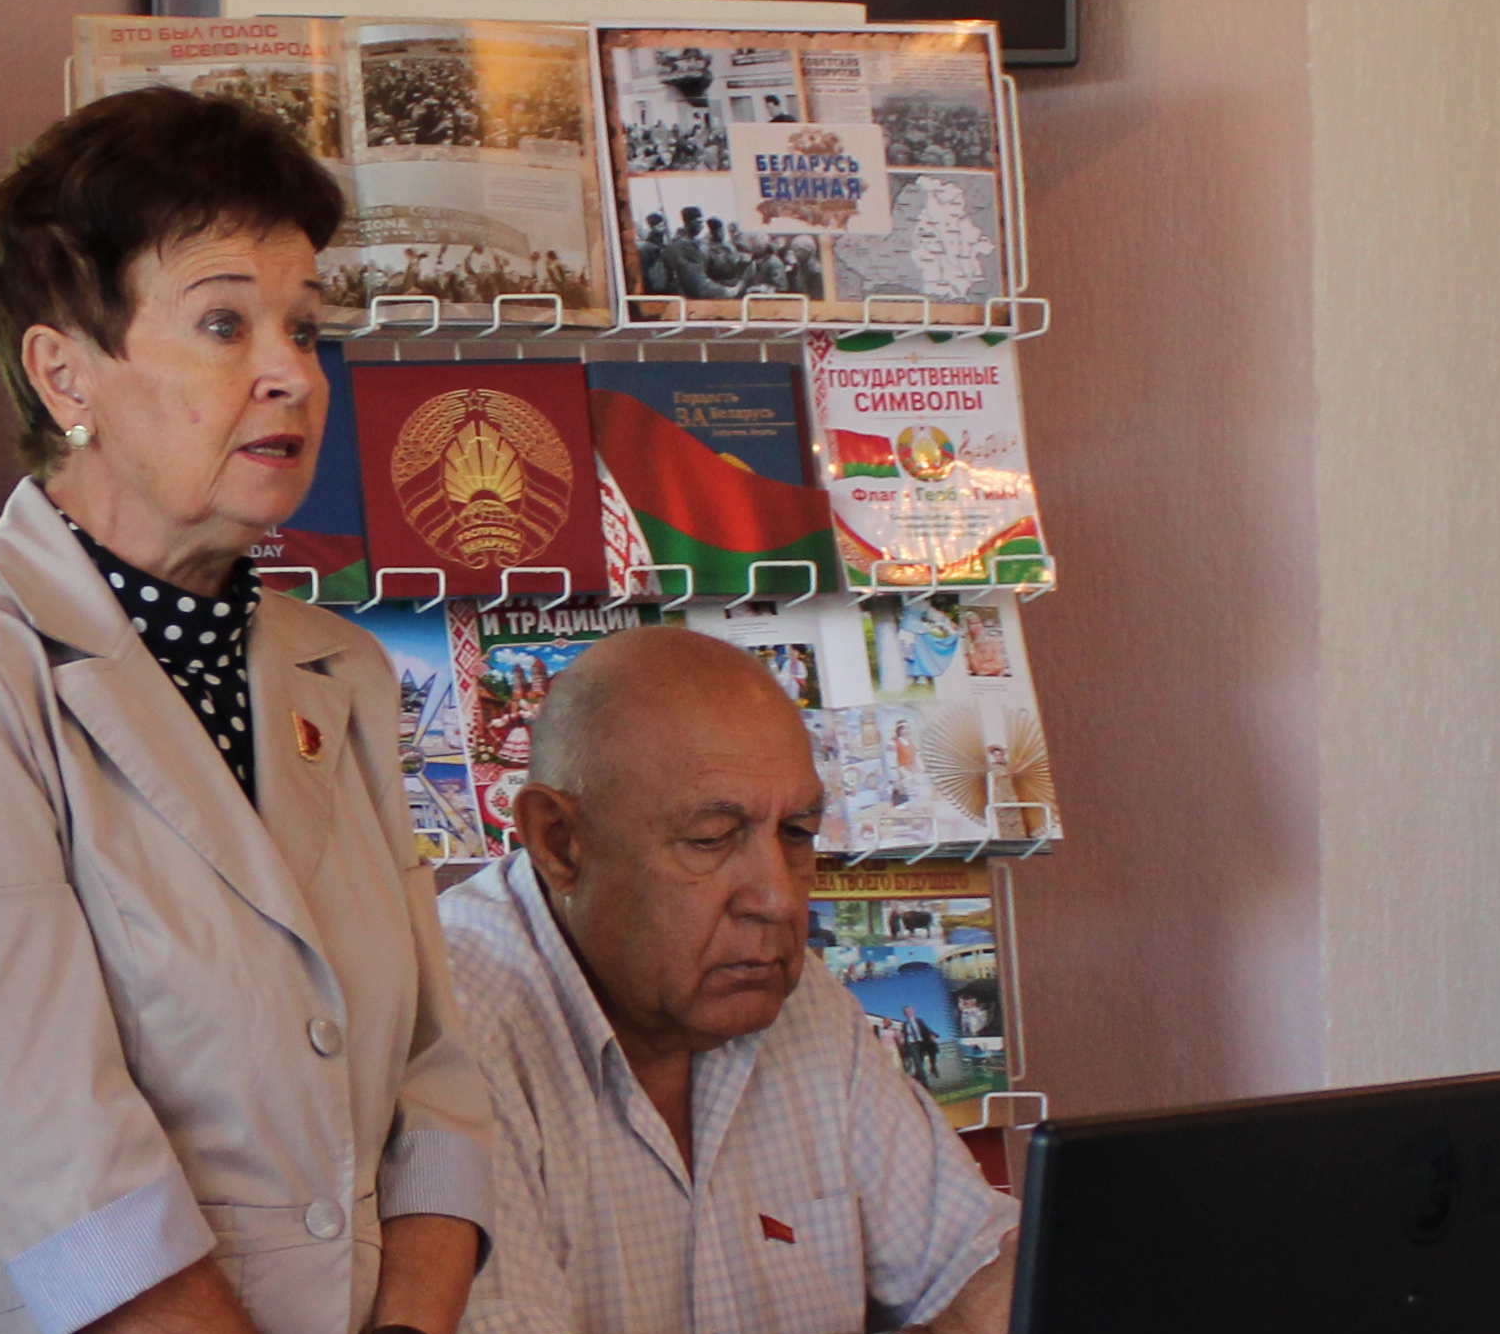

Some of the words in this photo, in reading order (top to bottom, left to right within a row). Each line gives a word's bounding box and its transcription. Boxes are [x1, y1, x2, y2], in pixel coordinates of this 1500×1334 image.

[111, 28, 153, 43] ЭТО
[158, 26, 203, 41] БЫЛ
[209, 23, 280, 40] ГОЛОС
[170, 42, 239, 59] ВСЕГО
[754, 152, 861, 175] БЕЛАРУСЬ
[759, 176, 862, 201] ЕДИНАЯ
[828, 365, 1000, 390] ГОСУДАРСТВЕННЫЕ
[854, 389, 984, 413] СИМВОЛЫ
[851, 486, 898, 503] Флаг
[916, 486, 957, 503] Герб
[972, 486, 1019, 502] Гимн
[482, 612, 501, 637] И
[505, 606, 642, 637] ТРАДИЦИИ
